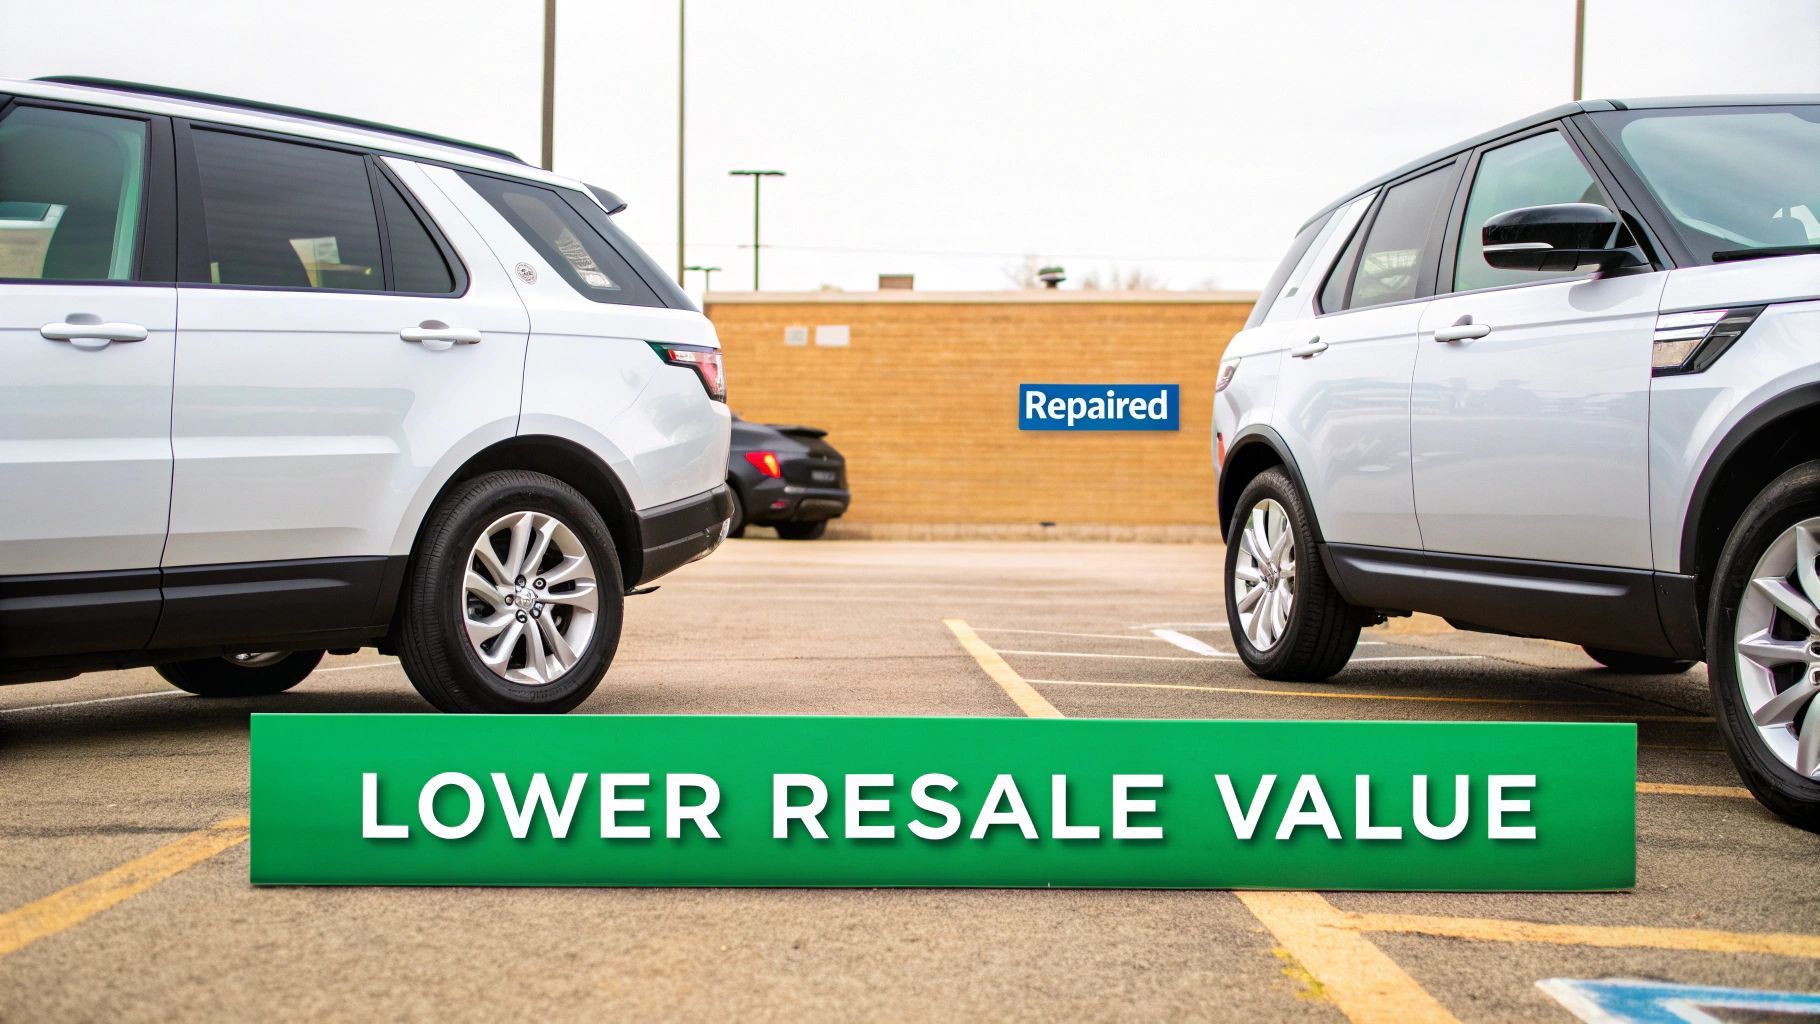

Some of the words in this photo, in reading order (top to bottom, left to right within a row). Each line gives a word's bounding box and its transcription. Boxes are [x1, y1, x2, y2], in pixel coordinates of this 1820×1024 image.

[1025, 389, 1168, 427] Repaired
[362, 771, 721, 840] LOWER
[773, 773, 1164, 840] RESALE
[1215, 774, 1537, 841] VALUE
